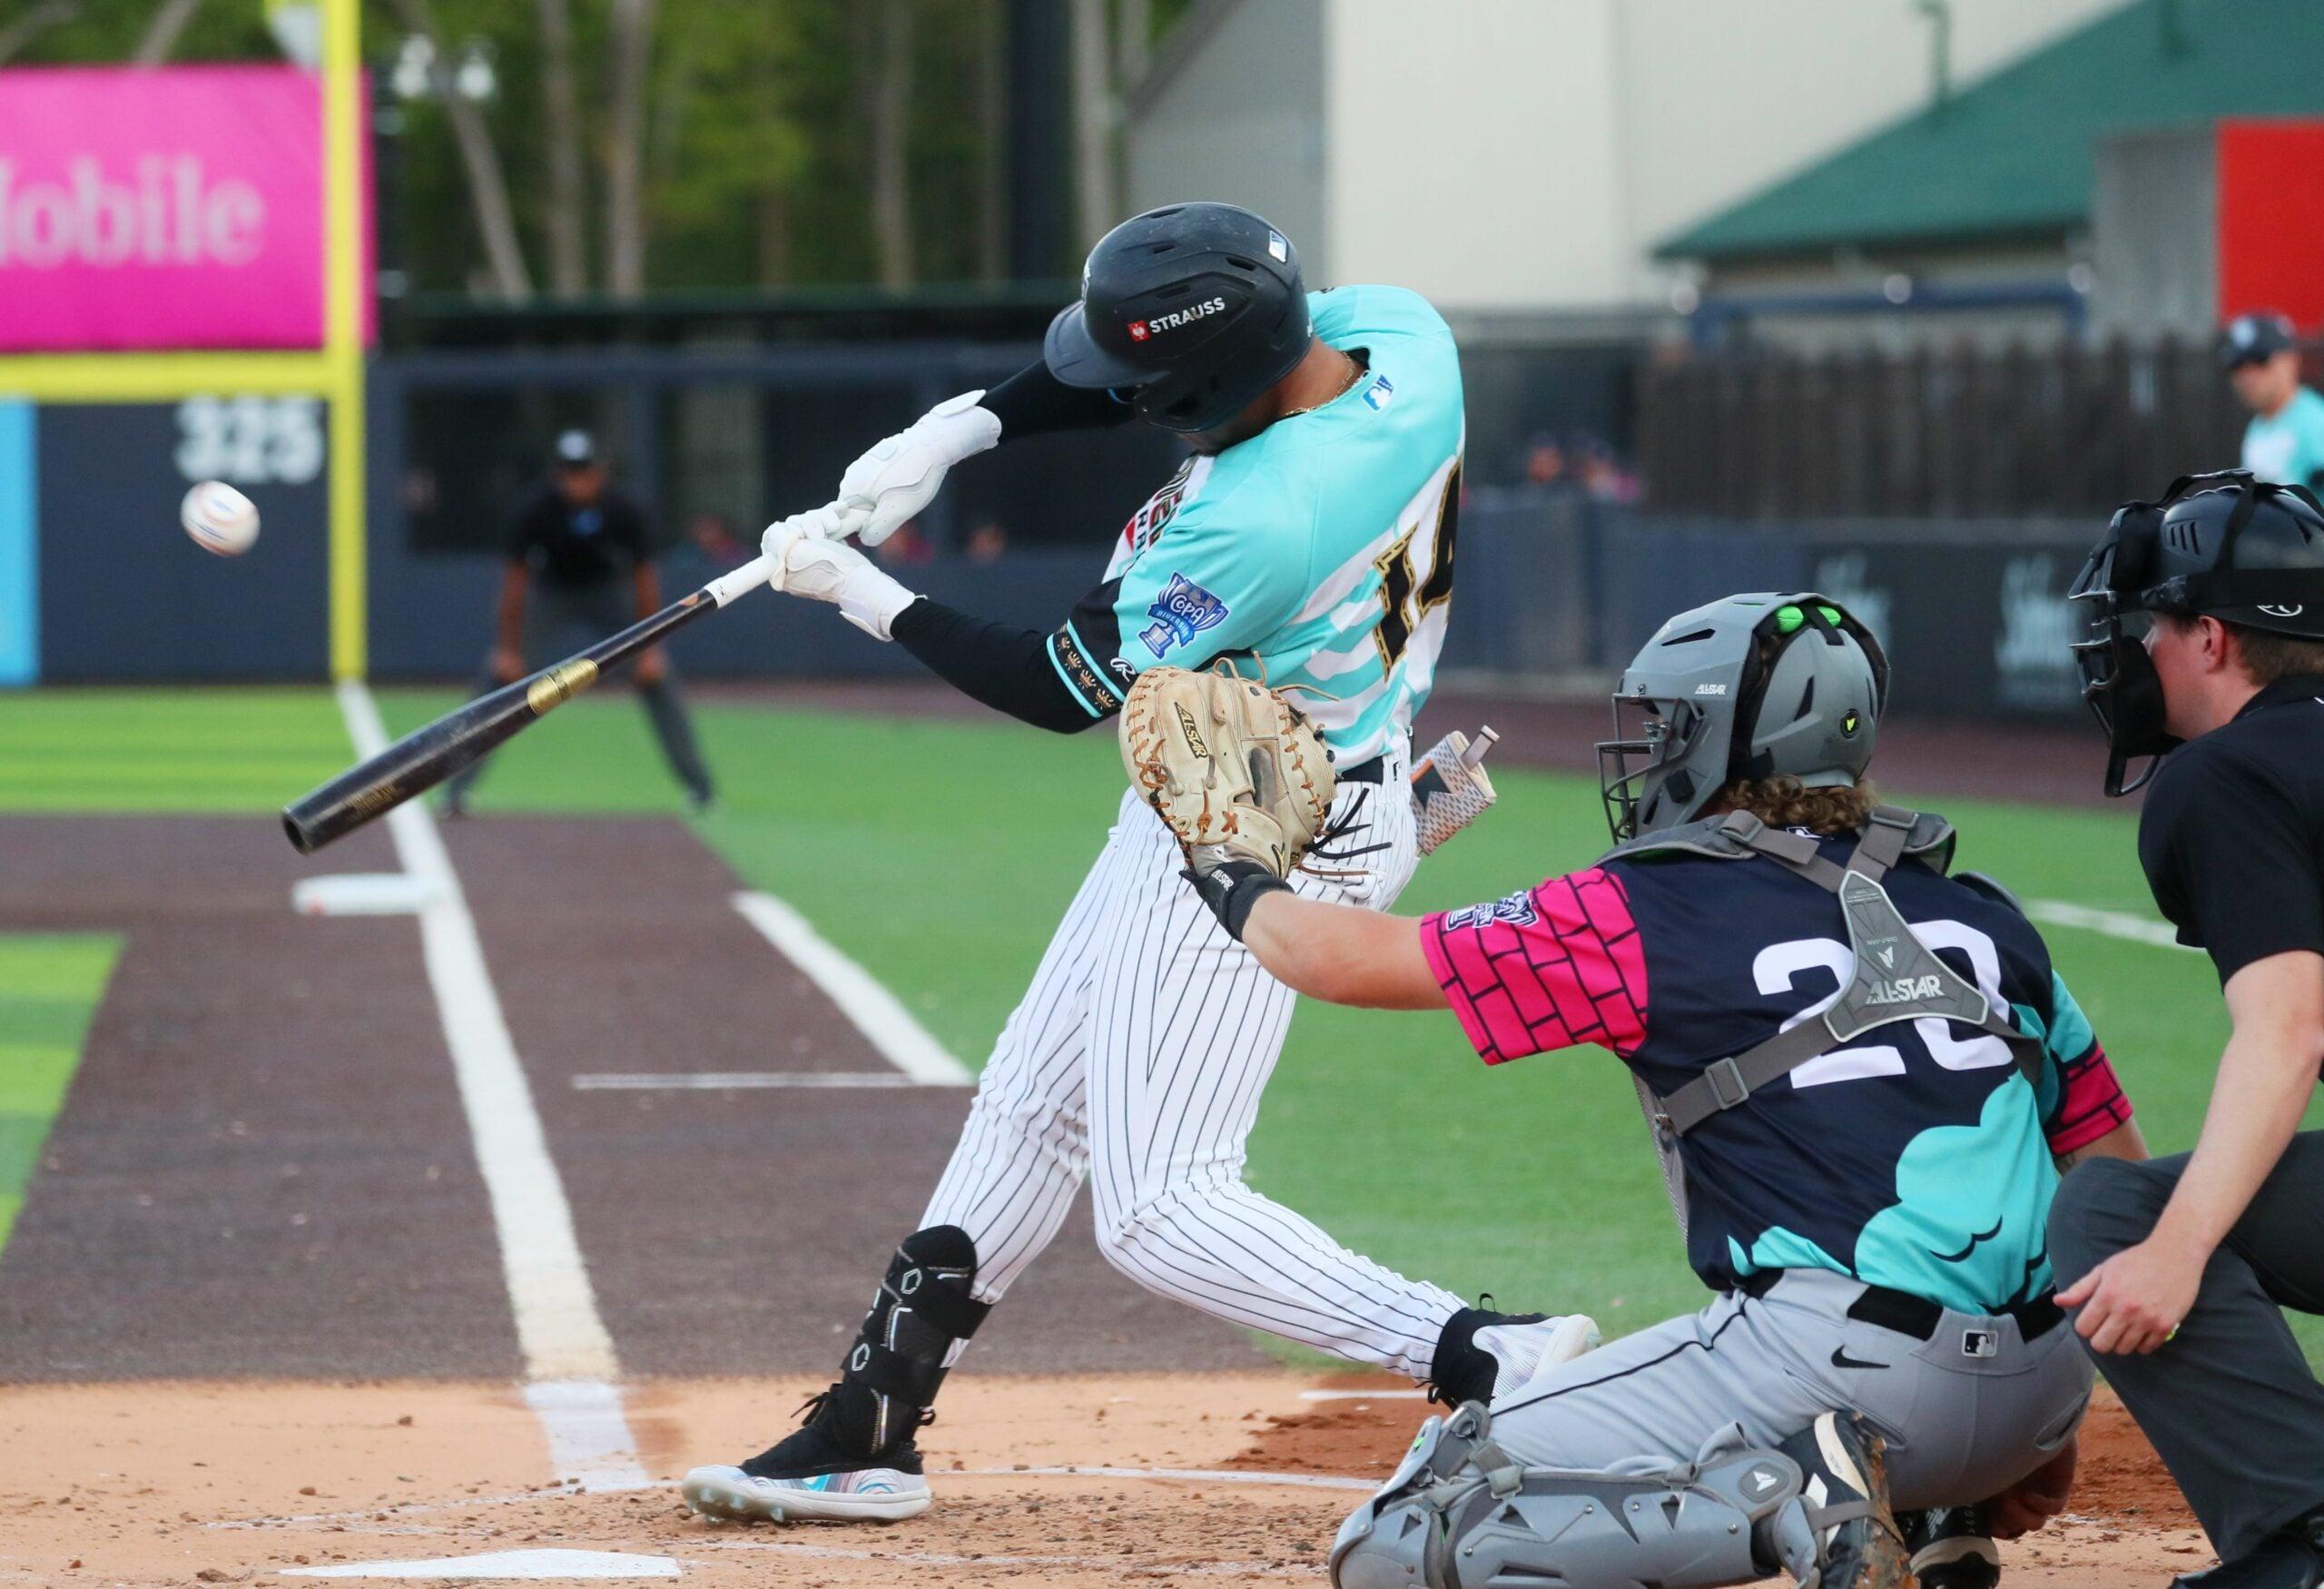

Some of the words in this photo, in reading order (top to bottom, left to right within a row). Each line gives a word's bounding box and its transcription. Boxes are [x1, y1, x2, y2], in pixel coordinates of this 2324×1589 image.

[1149, 297, 1226, 333] STRAUSS
[174, 396, 324, 483] 325
[1866, 974, 1945, 1005] ALL-STAR
